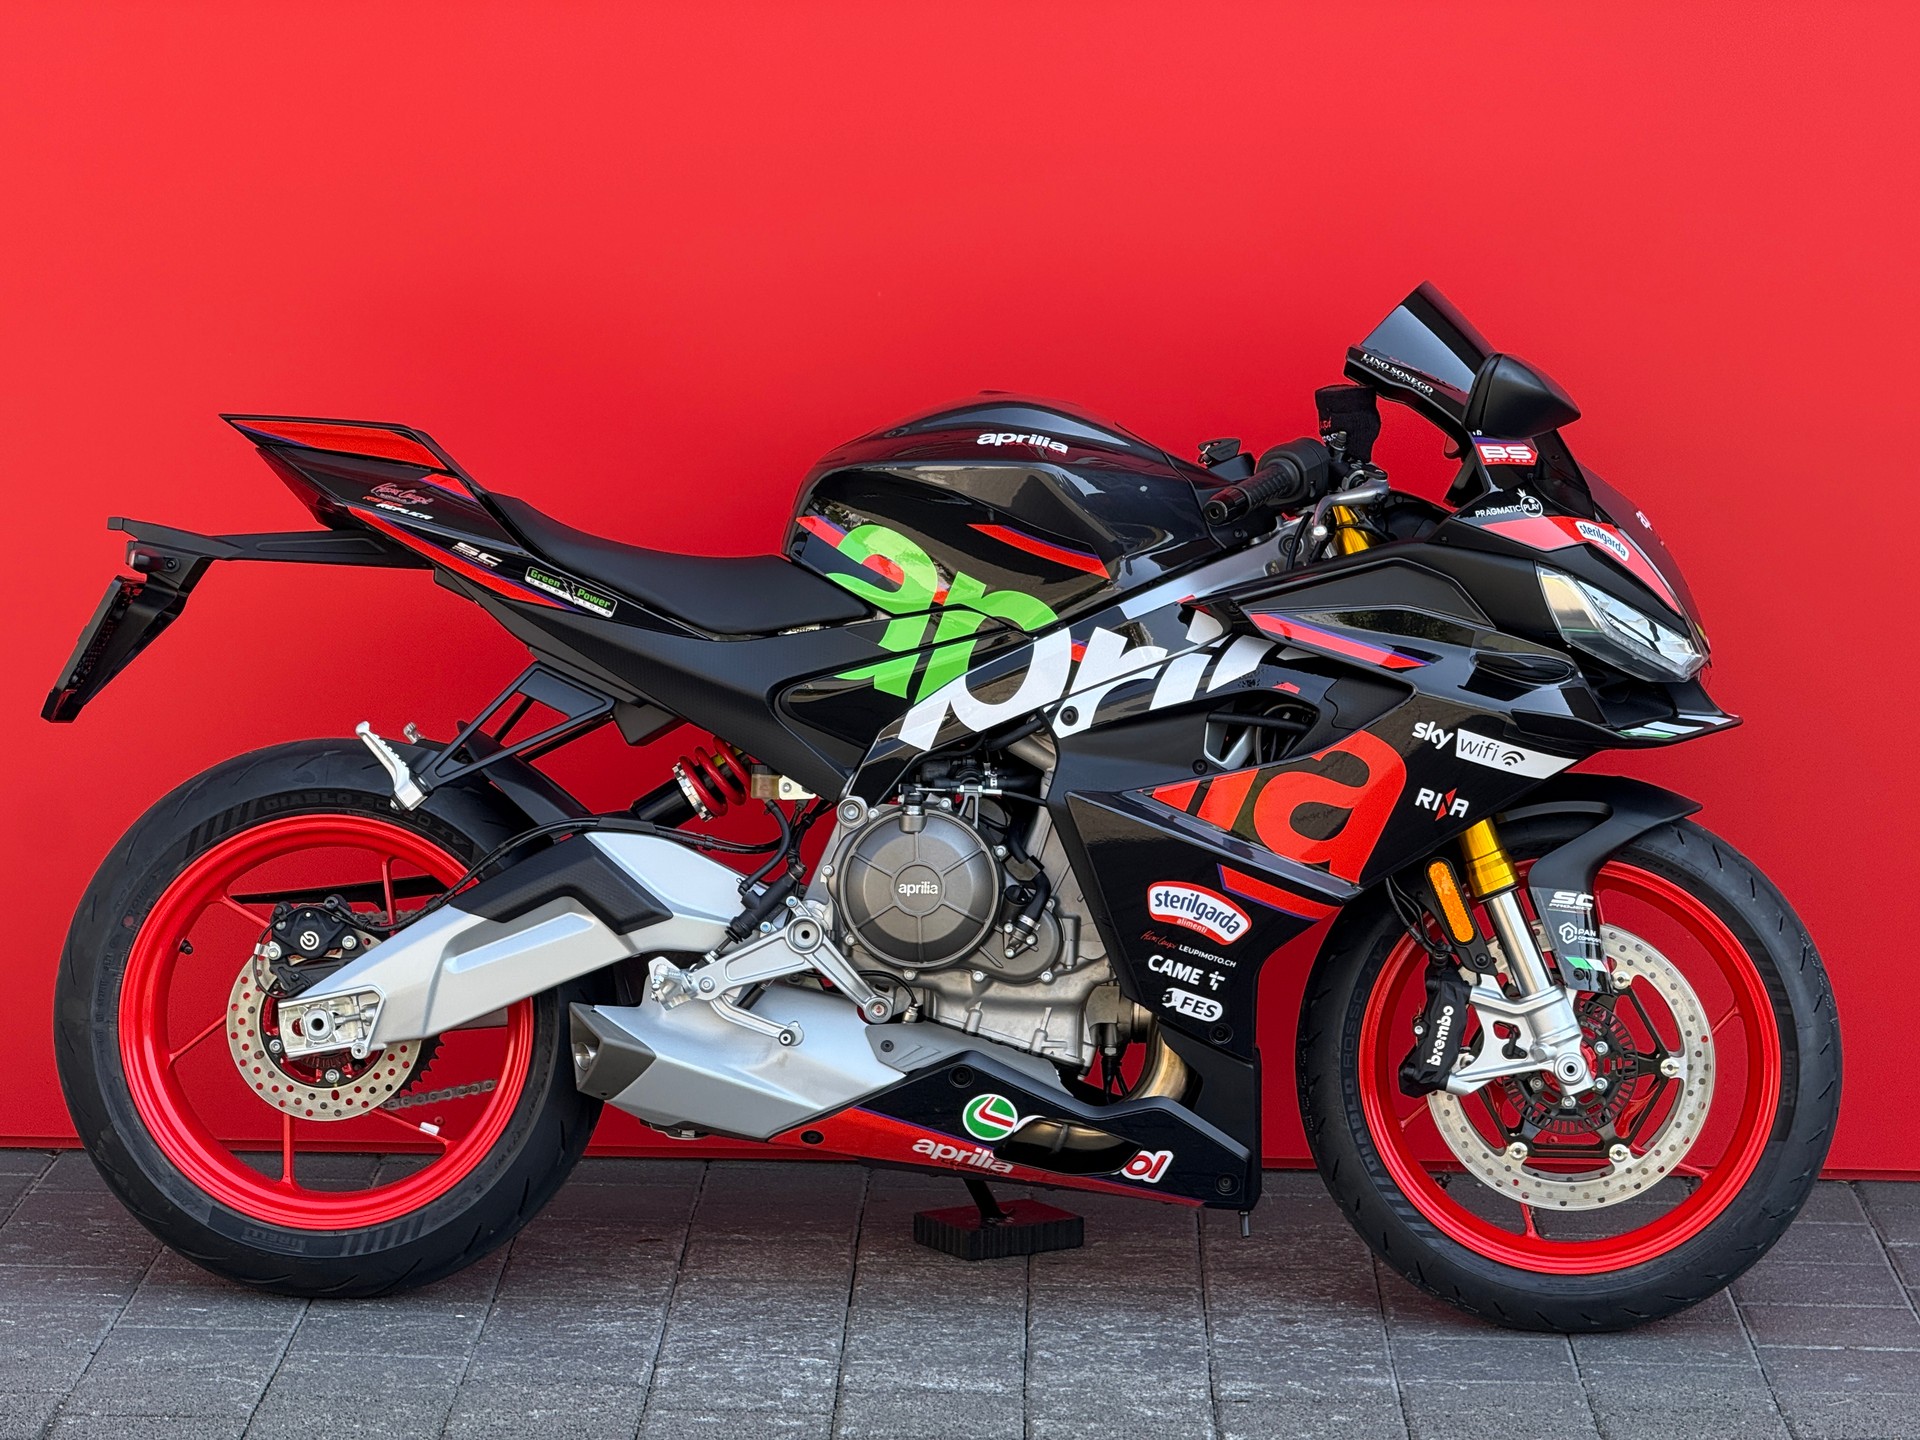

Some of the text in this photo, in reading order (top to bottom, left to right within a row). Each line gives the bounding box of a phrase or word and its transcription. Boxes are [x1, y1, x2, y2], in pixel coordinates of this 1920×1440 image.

[1362, 353, 1390, 370] LINO
[1391, 366, 1434, 393] SONEGO
[976, 432, 1069, 455] aprilia
[1479, 445, 1532, 459] BS
[1474, 502, 1540, 518] PRAGMATIC PLAY
[1579, 523, 1627, 557] sterilgarda
[530, 569, 611, 609] Green Power
[1411, 721, 1500, 761] sky wifi
[263, 791, 354, 812] DIABLO
[1414, 787, 1470, 821] RINA
[898, 881, 938, 897] aprilia
[1550, 891, 1594, 908] SC
[1154, 890, 1241, 934] sterilgarda
[1176, 918, 1208, 934] alimenti
[1578, 928, 1597, 937] PAN
[1147, 955, 1204, 986] CAME
[1178, 944, 1238, 968] LEUPIMOTO.CH
[1179, 996, 1218, 1018] FES
[1343, 989, 1366, 1069] ROSSO
[1426, 1005, 1454, 1066] brembo
[1343, 1077, 1381, 1171] DIABLO
[911, 1138, 1015, 1174] aprilia
